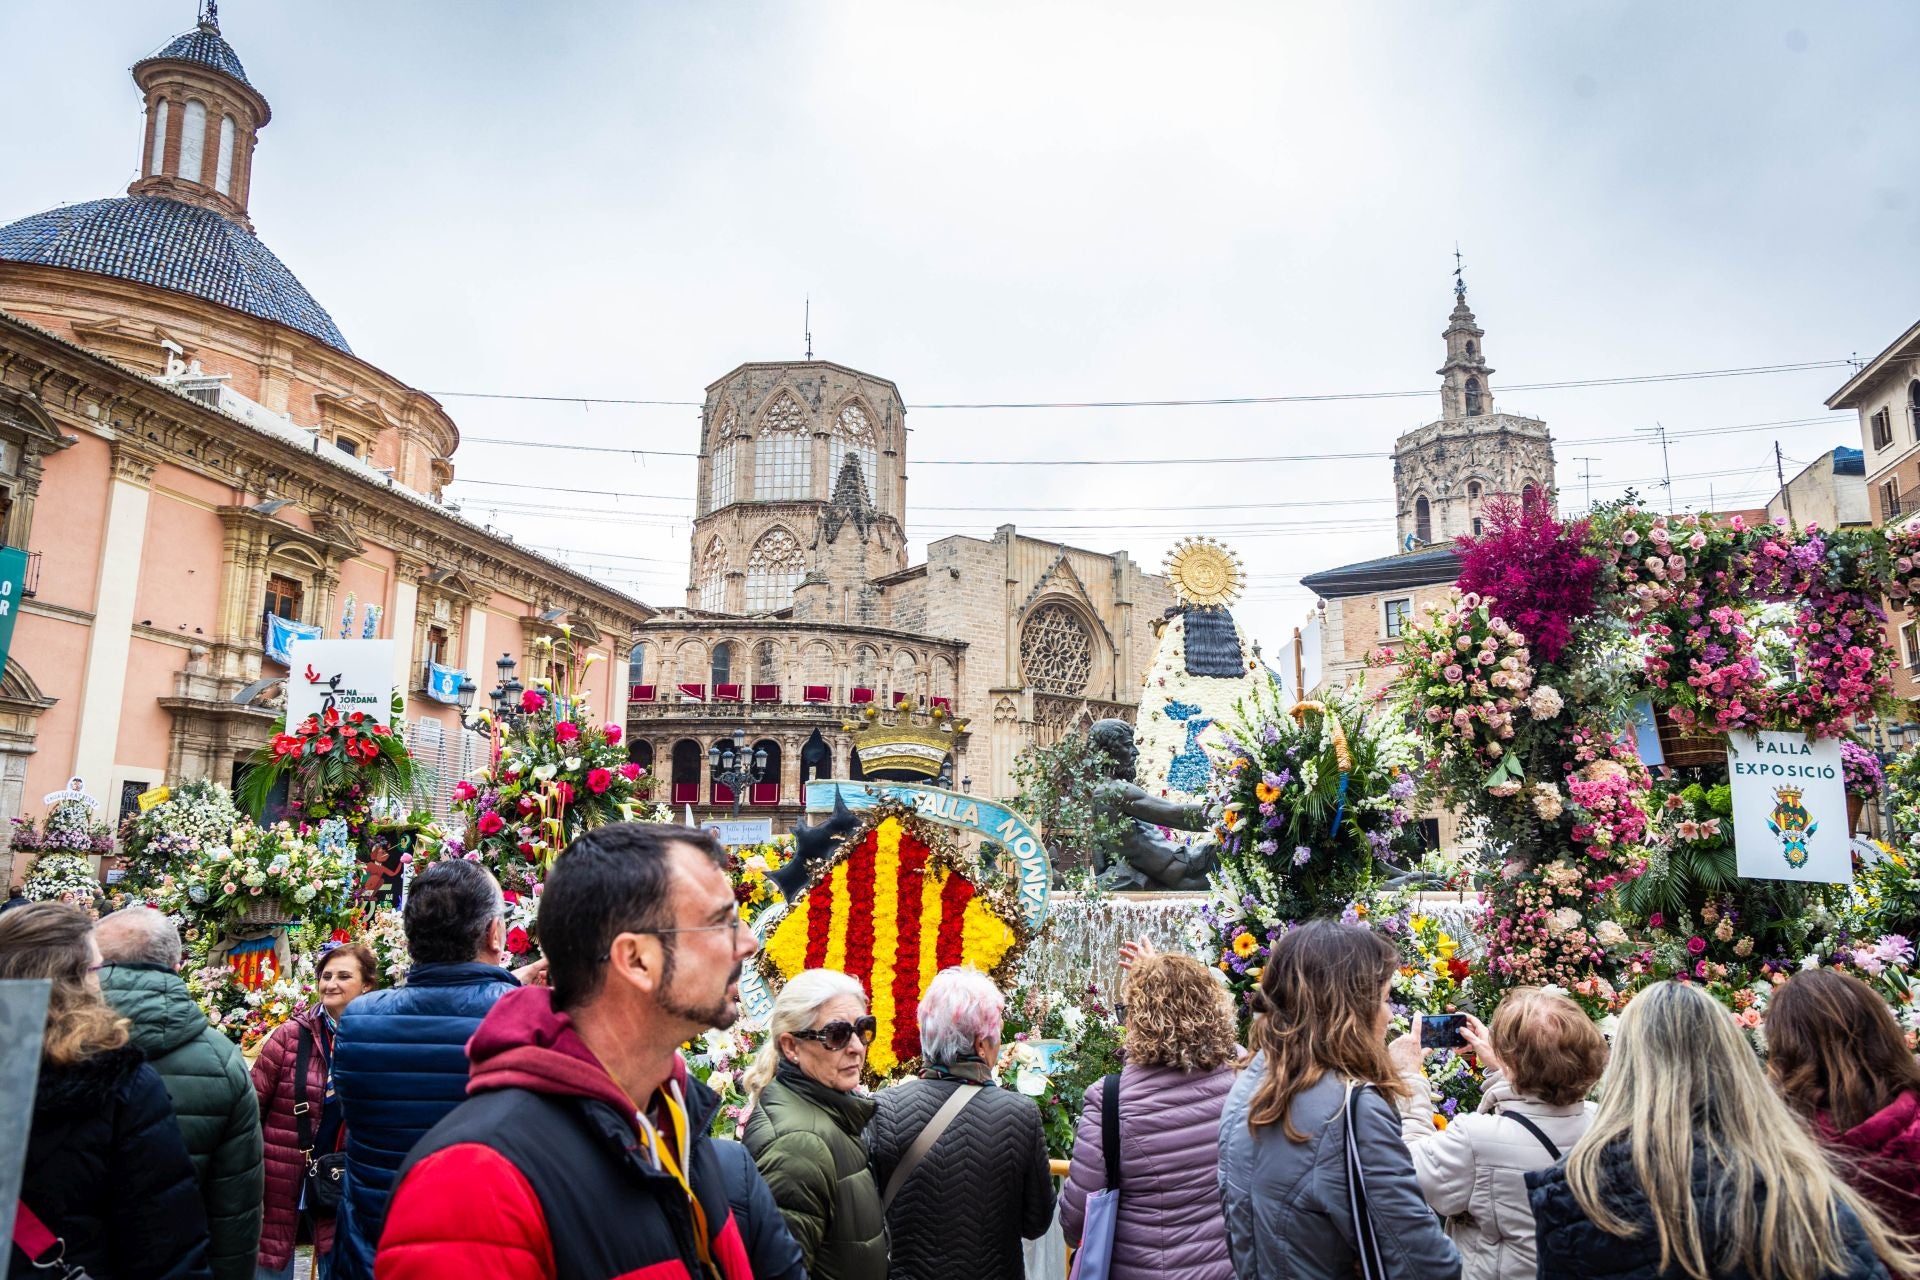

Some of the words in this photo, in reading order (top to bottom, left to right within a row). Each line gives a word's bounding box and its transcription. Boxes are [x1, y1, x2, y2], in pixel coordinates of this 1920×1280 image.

[0, 580, 12, 596] O
[339, 696, 378, 704] JORDANA
[1756, 741, 1811, 755] FALLA
[1735, 763, 1835, 779] EXPOSICIÓ
[915, 791, 980, 827] FALLA
